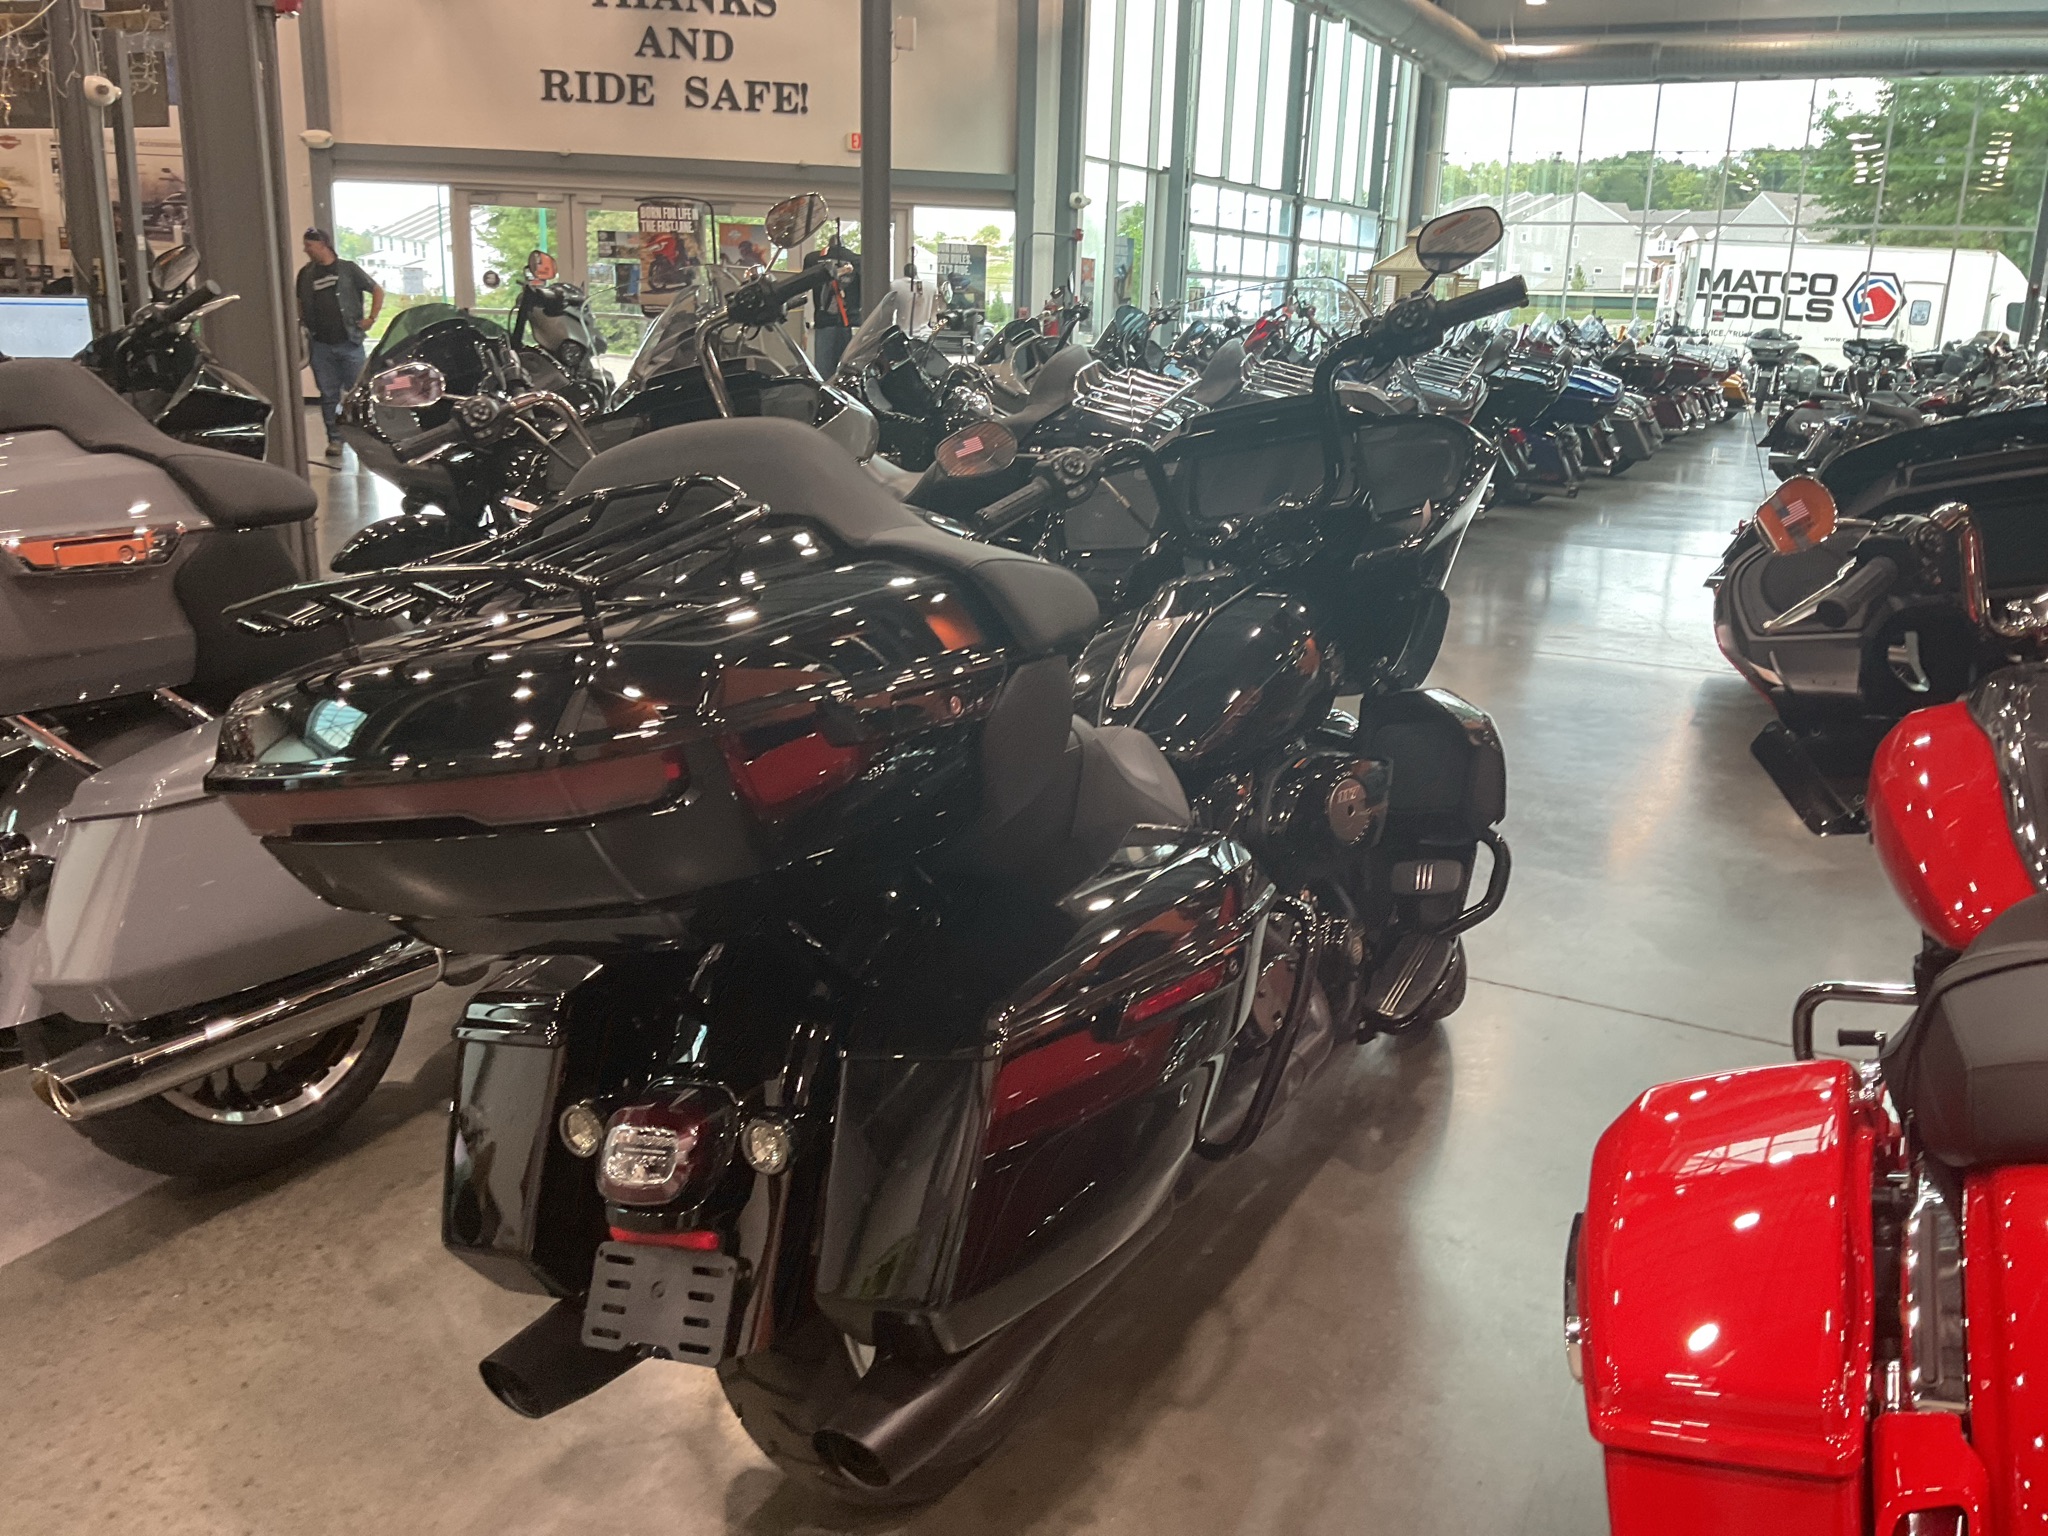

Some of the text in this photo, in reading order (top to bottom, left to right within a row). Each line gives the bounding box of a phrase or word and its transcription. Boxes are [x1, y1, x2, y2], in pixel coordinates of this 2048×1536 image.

[634, 25, 734, 62] AND
[540, 69, 809, 115] RIDE SAFE!
[677, 207, 692, 220] LIFE
[1697, 268, 1839, 297] MATCO
[1696, 293, 1835, 323] TOOLS
